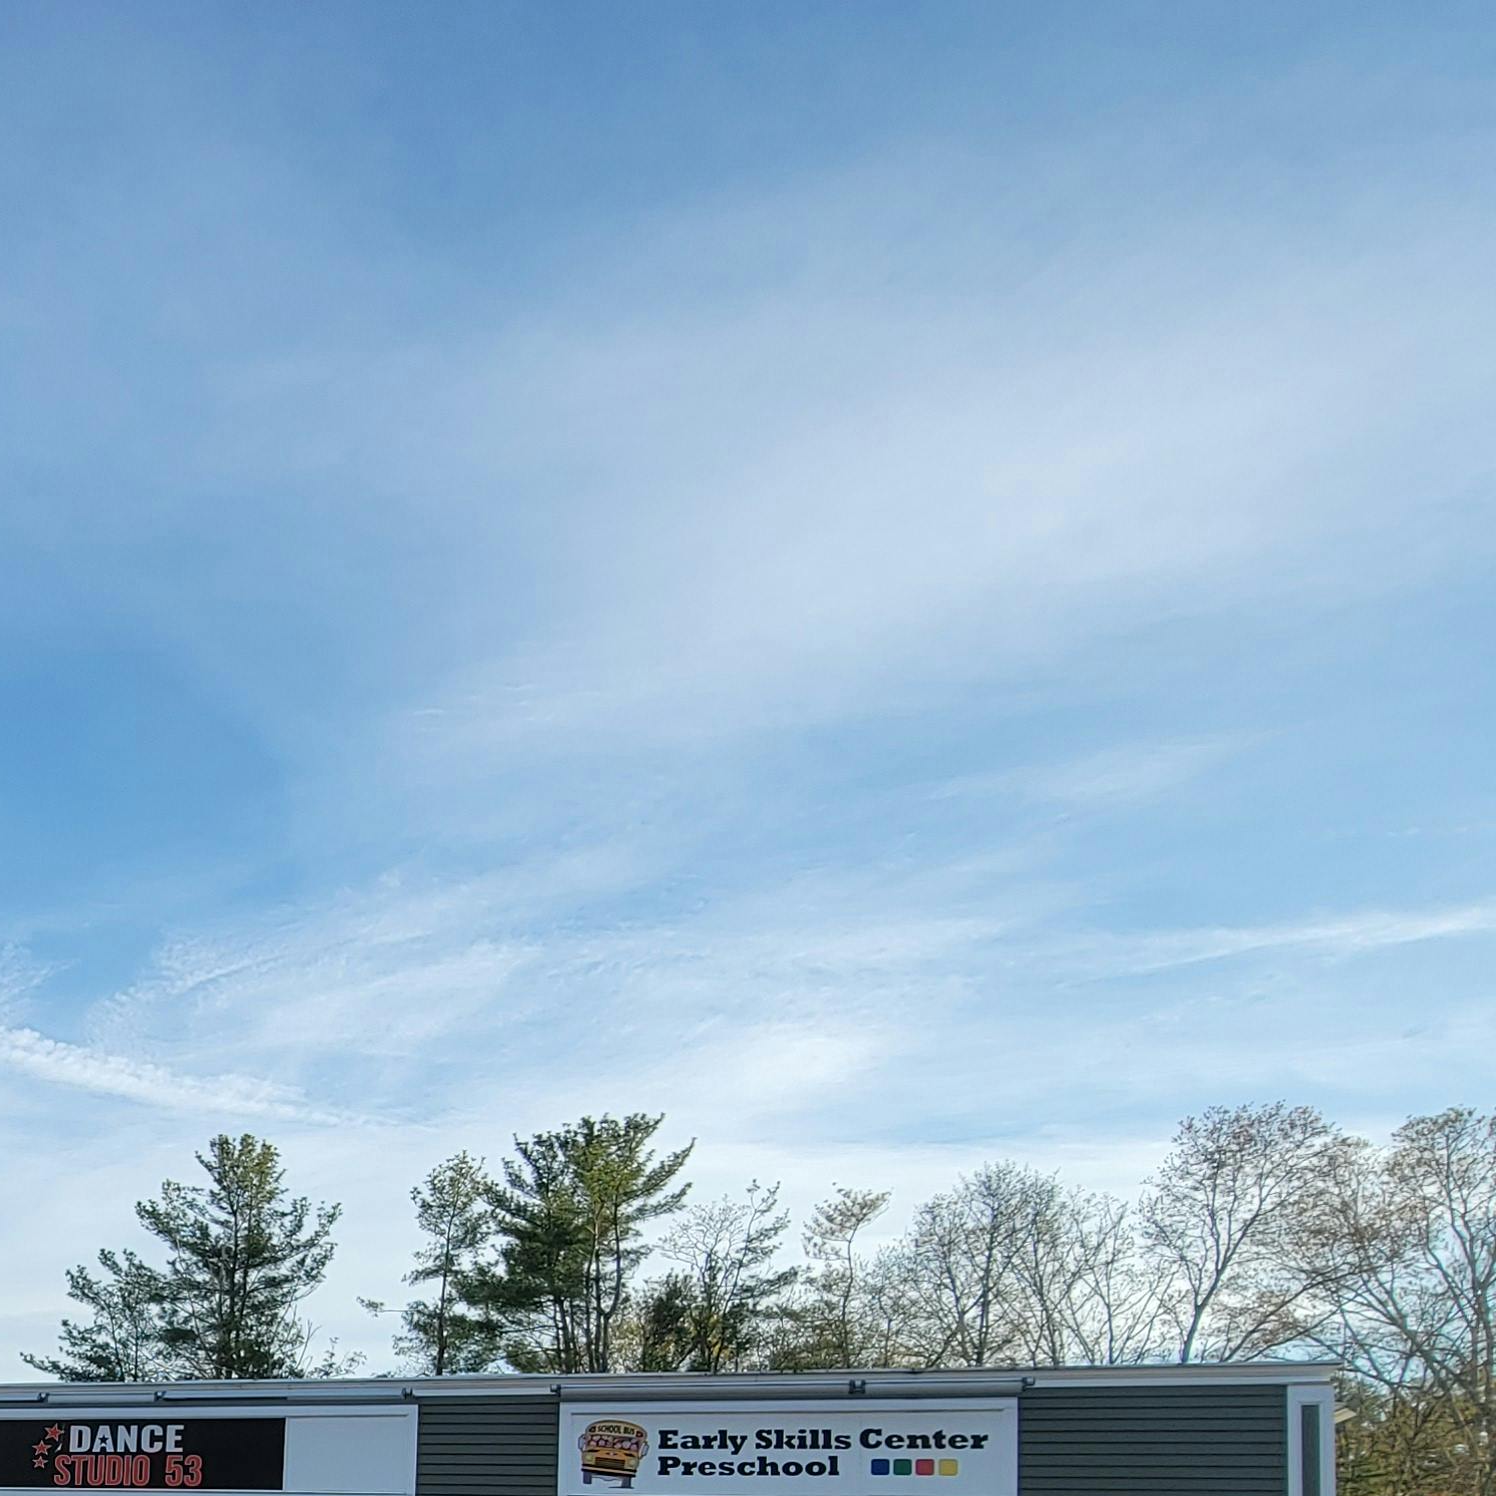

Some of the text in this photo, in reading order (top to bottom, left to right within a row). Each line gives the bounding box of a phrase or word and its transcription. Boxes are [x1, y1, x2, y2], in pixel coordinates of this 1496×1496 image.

[69, 1424, 185, 1453] DANCE
[657, 1428, 989, 1456] Early Skills Center
[54, 1455, 204, 1487] STUDIO 53
[657, 1456, 841, 1477] Preschool
